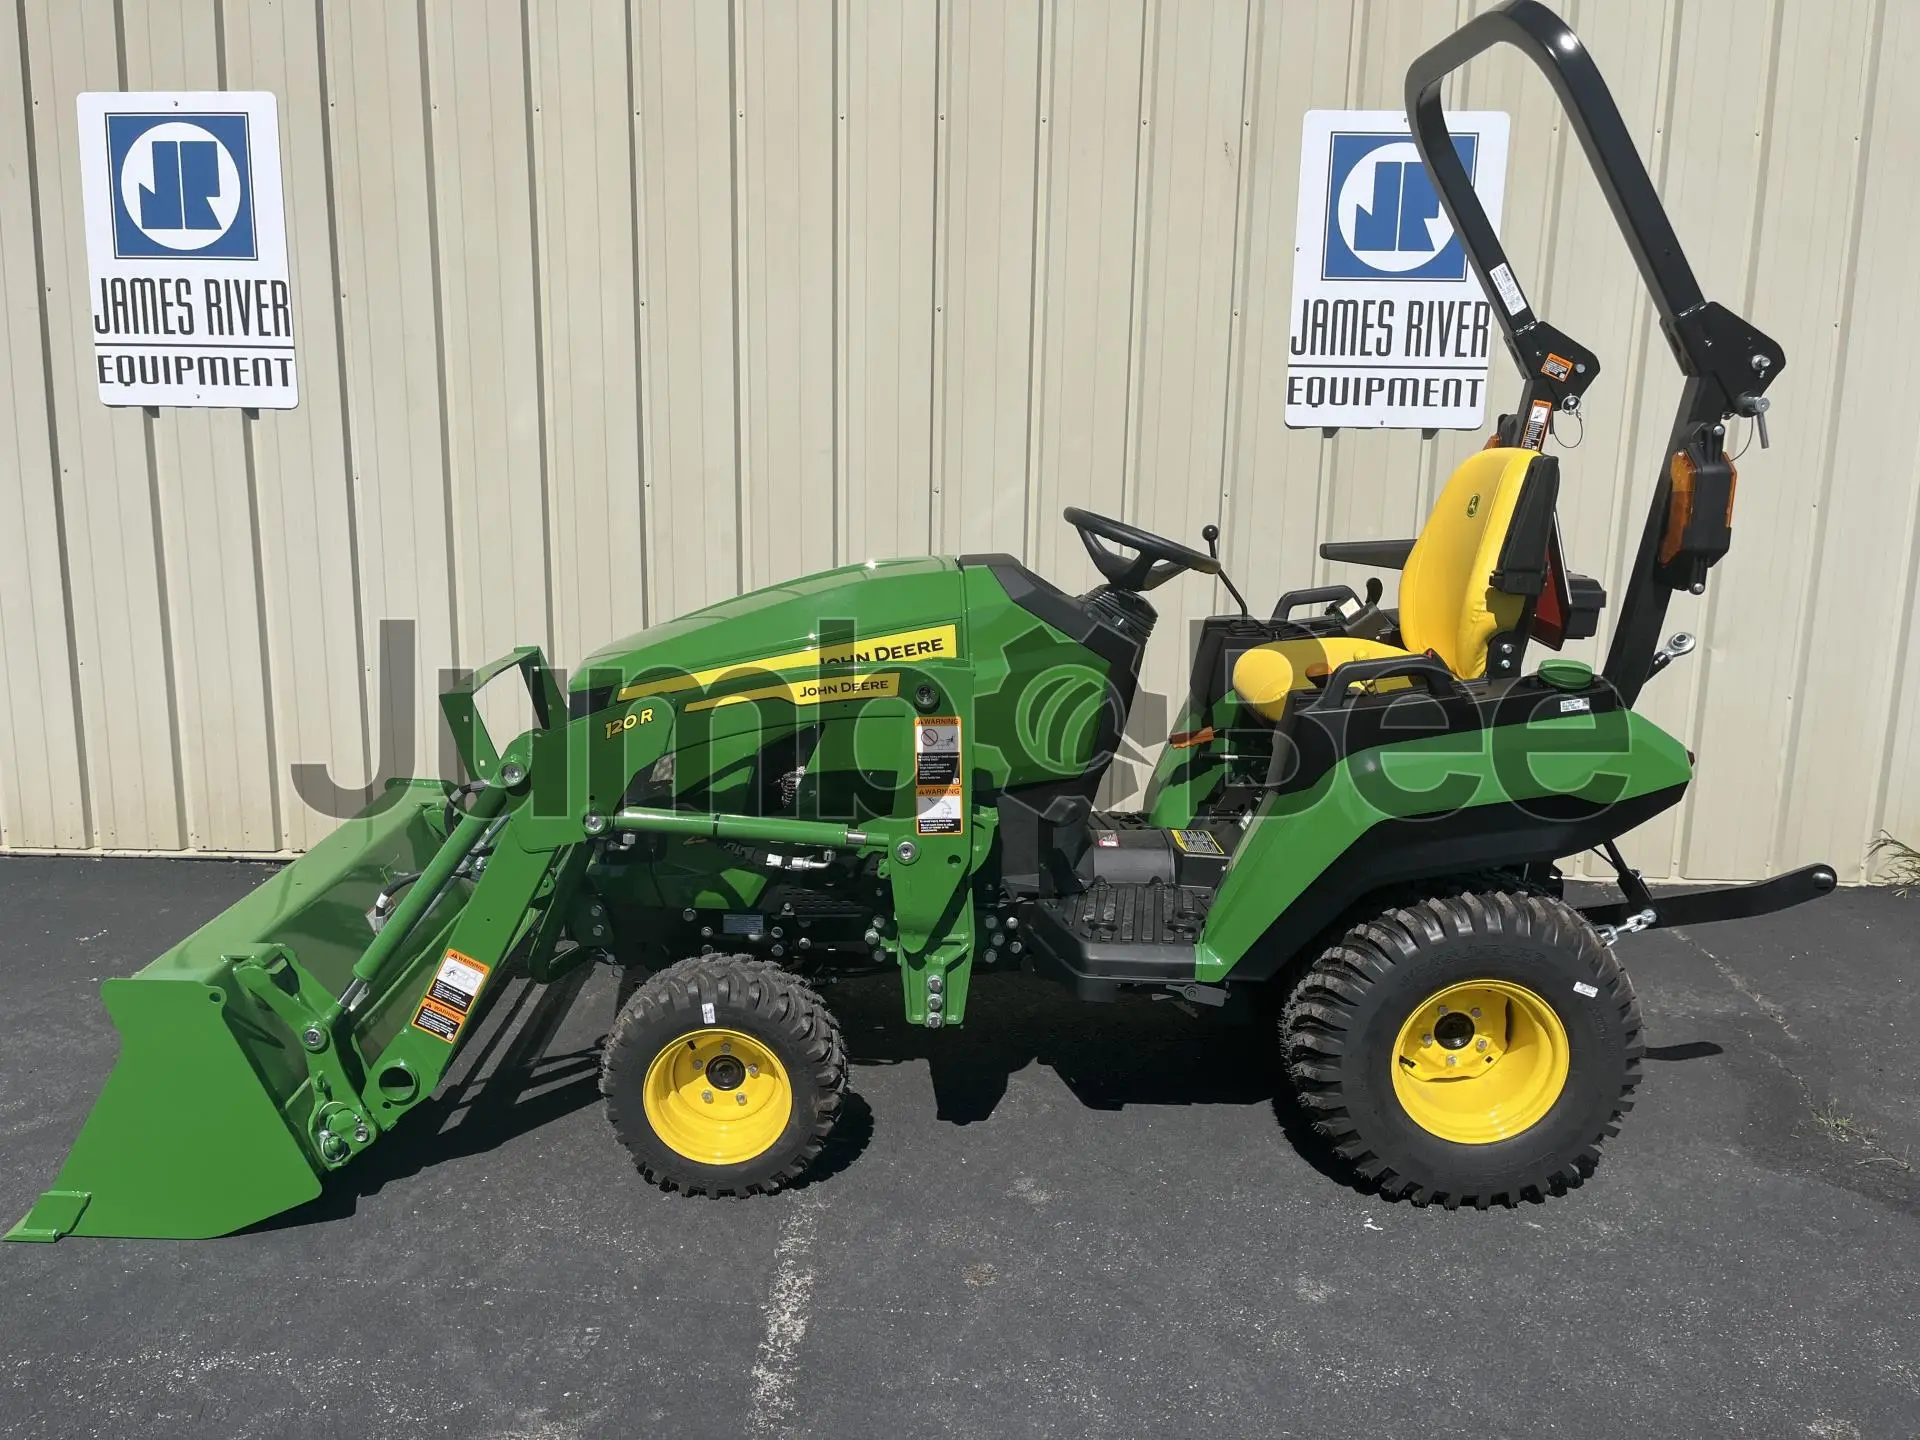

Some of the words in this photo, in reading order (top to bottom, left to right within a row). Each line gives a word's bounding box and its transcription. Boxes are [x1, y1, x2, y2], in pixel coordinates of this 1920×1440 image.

[94, 277, 194, 335] JAMES
[204, 278, 291, 337] RIVER
[1290, 299, 1395, 357] JAMES
[1404, 300, 1491, 358] RIVER
[97, 355, 293, 387] EQUIPMENT
[1287, 376, 1485, 408] EQUIPMENT
[874, 638, 944, 661] DEERE
[799, 684, 838, 698] JOHN
[841, 680, 889, 693] DEERE
[925, 788, 960, 796] WARNING
[458, 956, 485, 972] WARNING
[433, 1005, 460, 1021] WARNING
